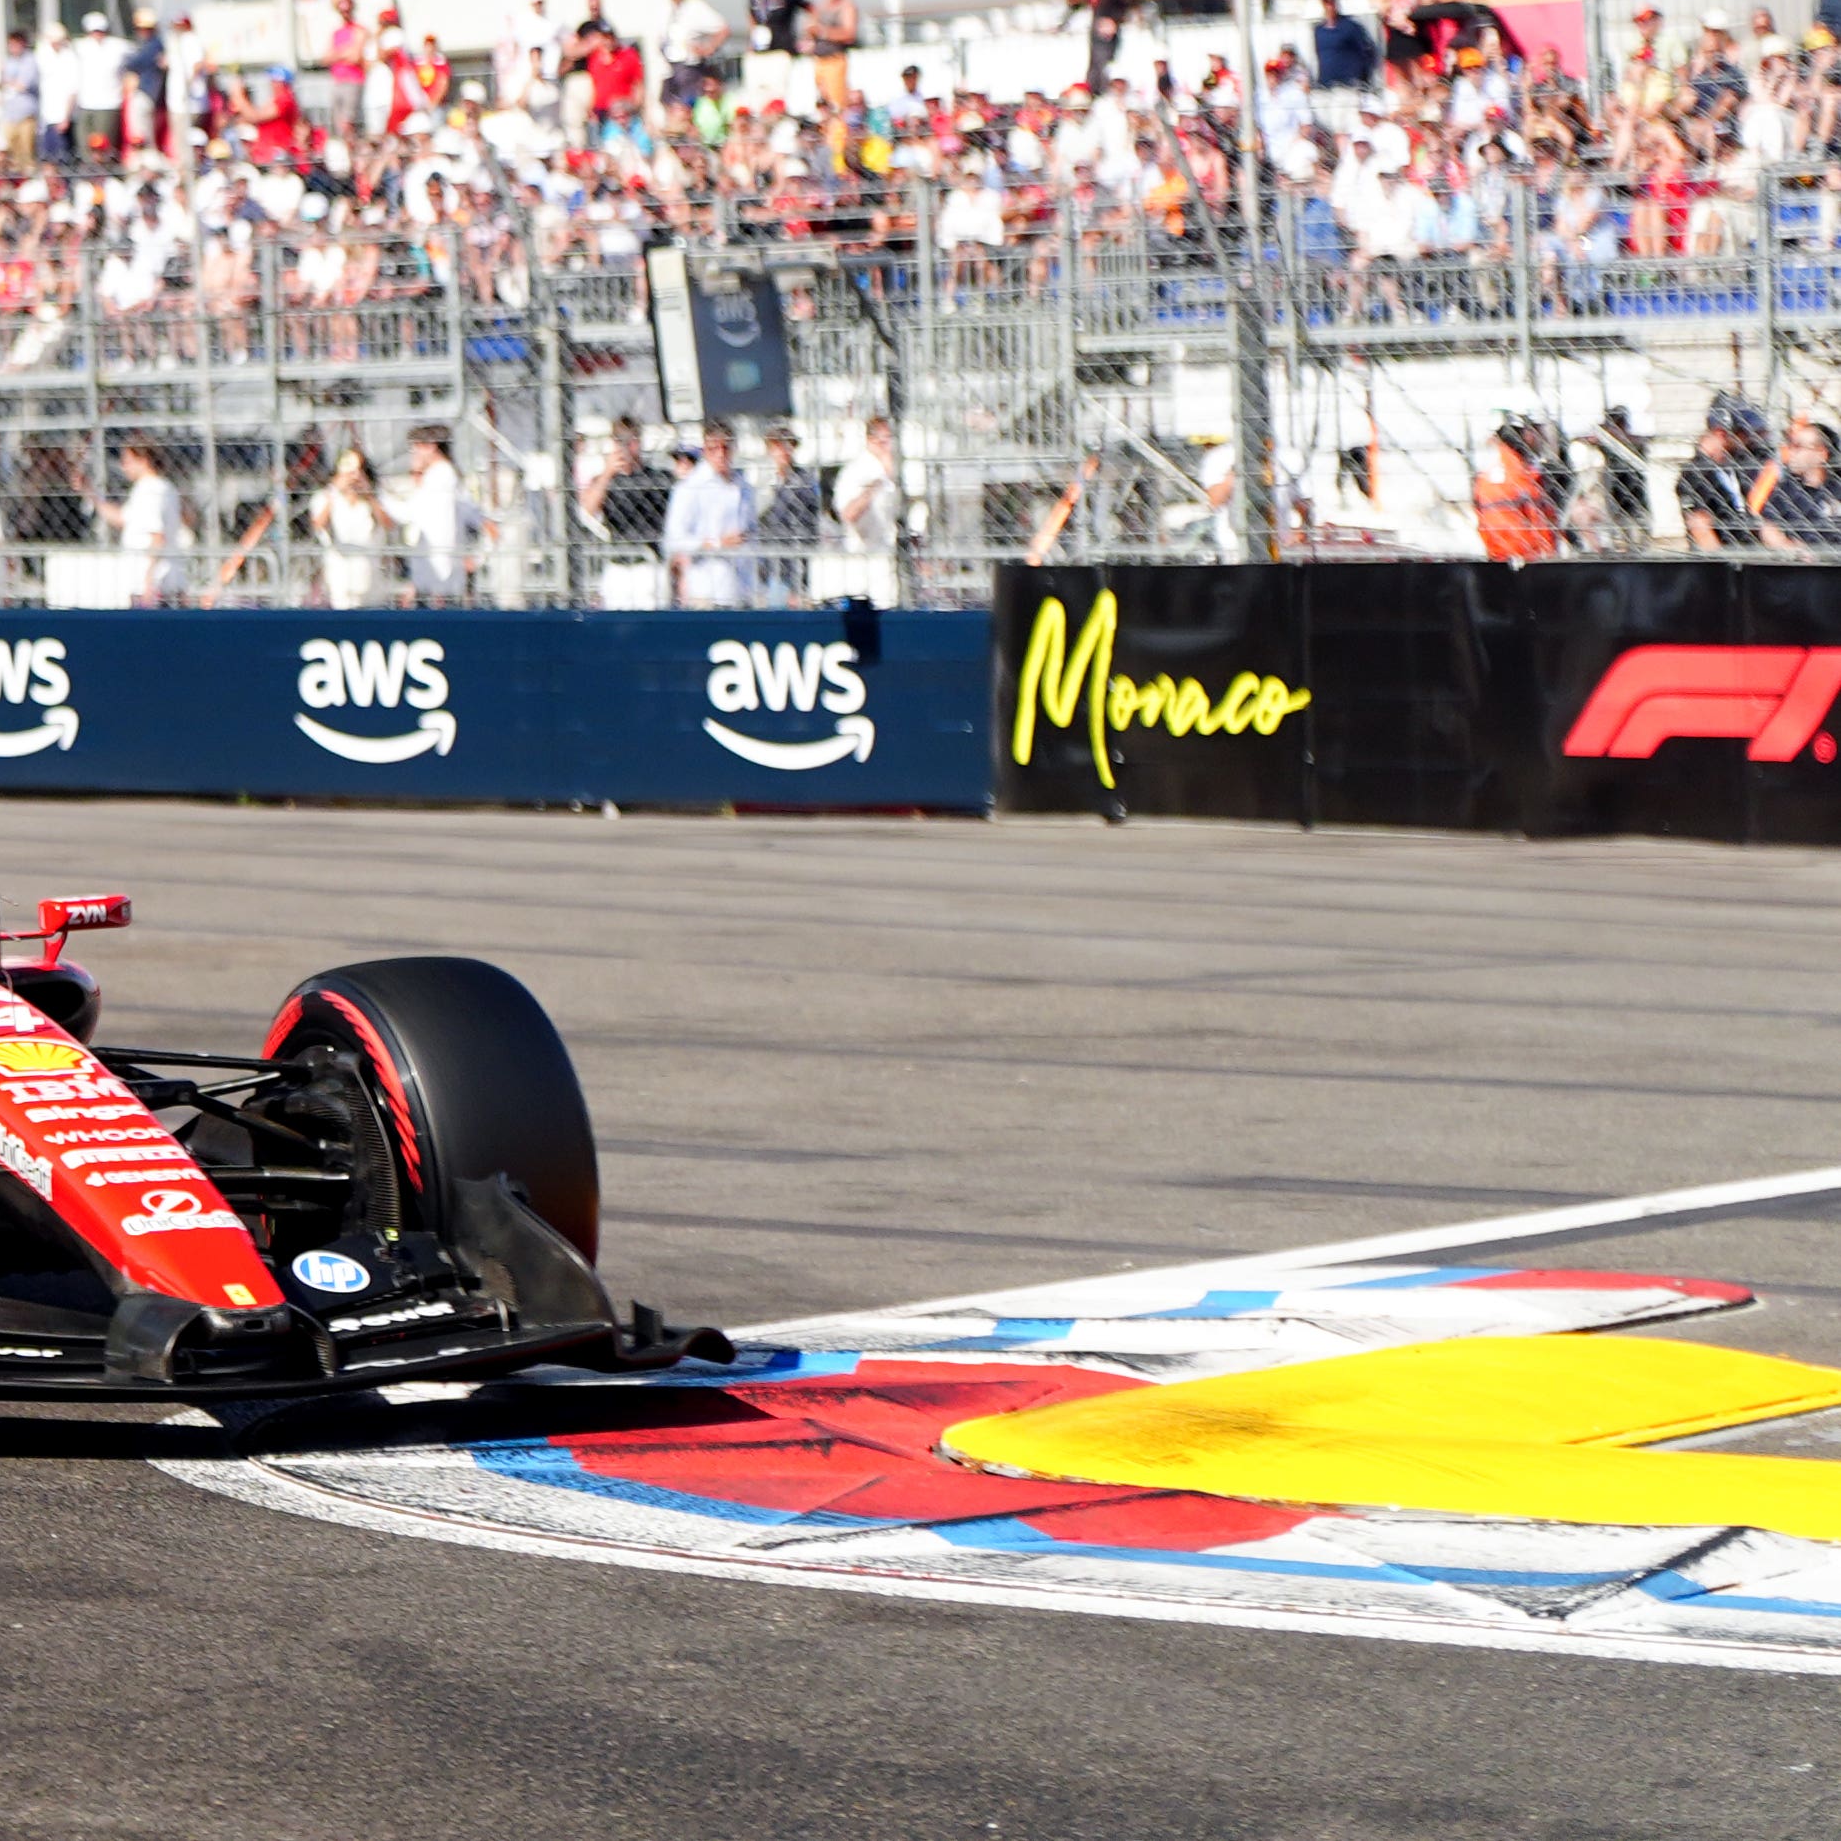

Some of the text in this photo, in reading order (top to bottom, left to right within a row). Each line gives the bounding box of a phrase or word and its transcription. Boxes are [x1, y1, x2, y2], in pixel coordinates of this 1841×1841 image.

[298, 638, 449, 710] aws
[707, 640, 866, 715] aws
[1013, 587, 1311, 790] Monaco
[66, 904, 108, 925] ZYN
[43, 1127, 170, 1145] WHOOP
